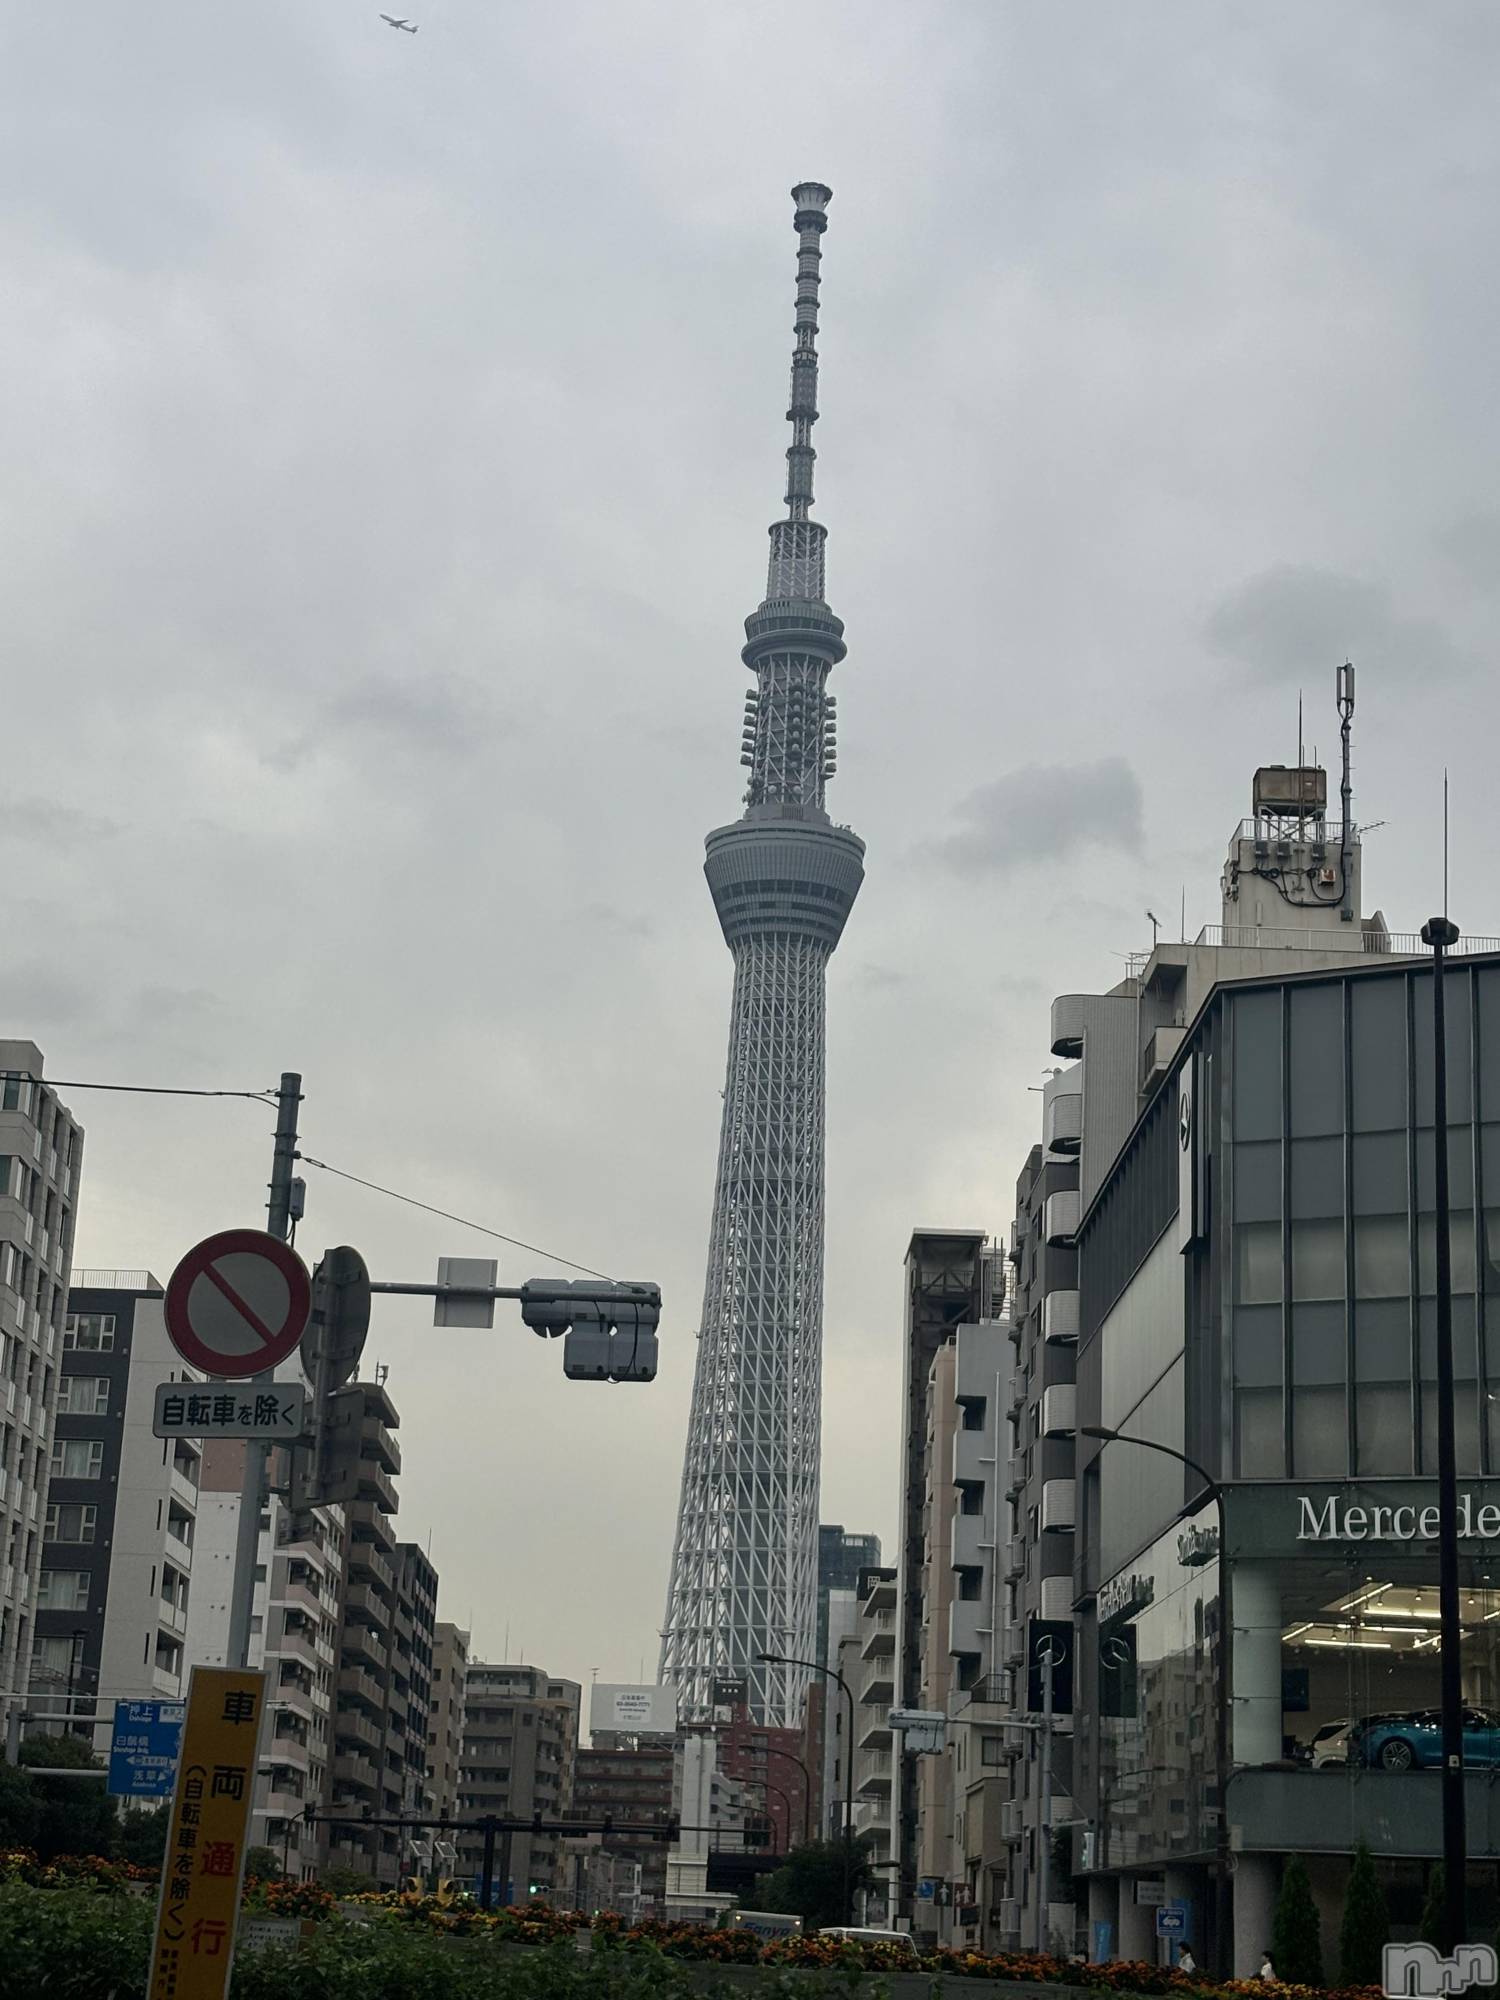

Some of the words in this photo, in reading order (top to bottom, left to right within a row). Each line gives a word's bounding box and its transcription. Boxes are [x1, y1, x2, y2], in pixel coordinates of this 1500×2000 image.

[162, 1394, 296, 1427] 自転車を除く
[190, 1690, 257, 1956] 車両通行
